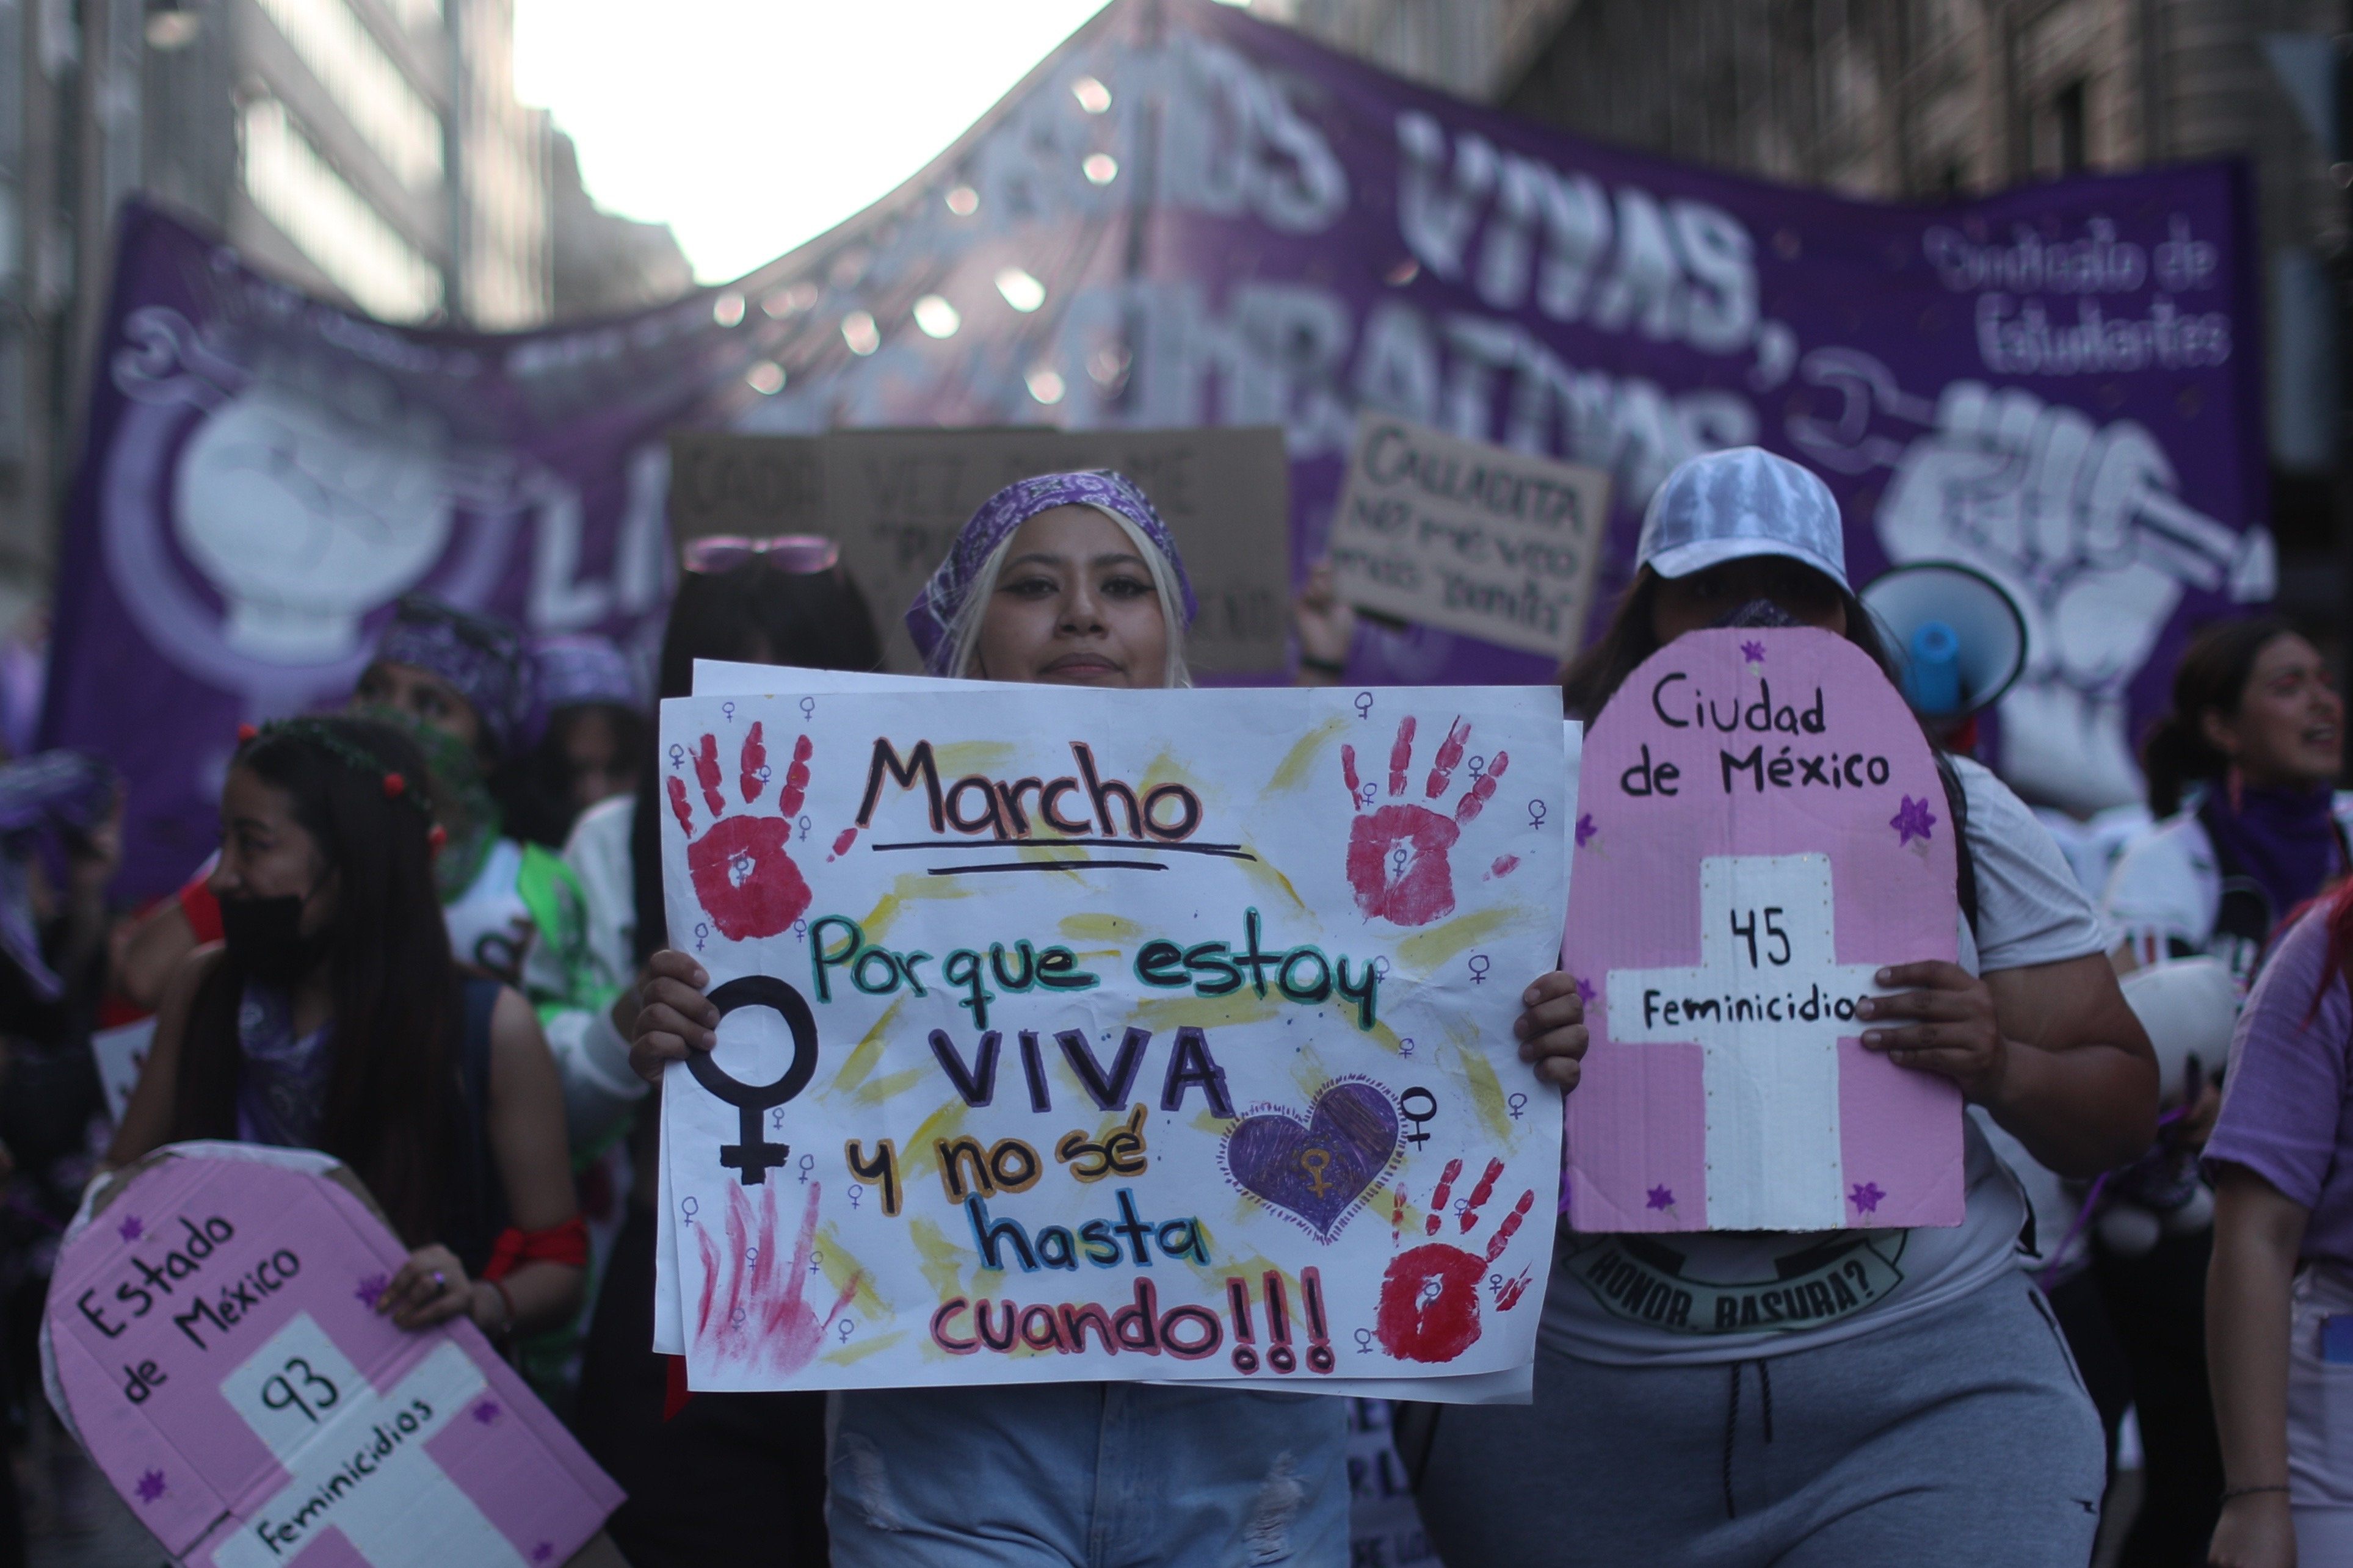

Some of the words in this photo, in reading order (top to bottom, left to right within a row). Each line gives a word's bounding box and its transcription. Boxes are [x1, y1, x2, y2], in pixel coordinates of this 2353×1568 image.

[1395, 109, 1798, 394] VIVAS,
[2153, 212, 2219, 292] de
[1976, 292, 2232, 375] Estudiantes
[1363, 426, 1583, 535] CALLADITA
[1651, 672, 1826, 736] Ciudad
[855, 736, 1203, 844] Marcho
[1620, 743, 1680, 796] de
[1719, 744, 1890, 793] México
[809, 914, 1100, 1030] Porque
[1133, 906, 1377, 1031] estoy
[1730, 906, 1791, 970] 45
[1644, 981, 1869, 1030] Feminicidio
[927, 1026, 1235, 1119] VIVA
[845, 1137, 902, 1218] y
[933, 1136, 1043, 1204] no
[1055, 1102, 1149, 1184] sé
[965, 1187, 1211, 1273] hasta
[77, 1215, 236, 1339] Estado
[930, 1265, 1336, 1375] cuando!!!
[1714, 1258, 1875, 1331] BASURA?
[123, 1359, 168, 1406] de
[173, 1248, 301, 1351] México
[259, 1356, 339, 1425] 93
[255, 1398, 435, 1555] Feminicidios
